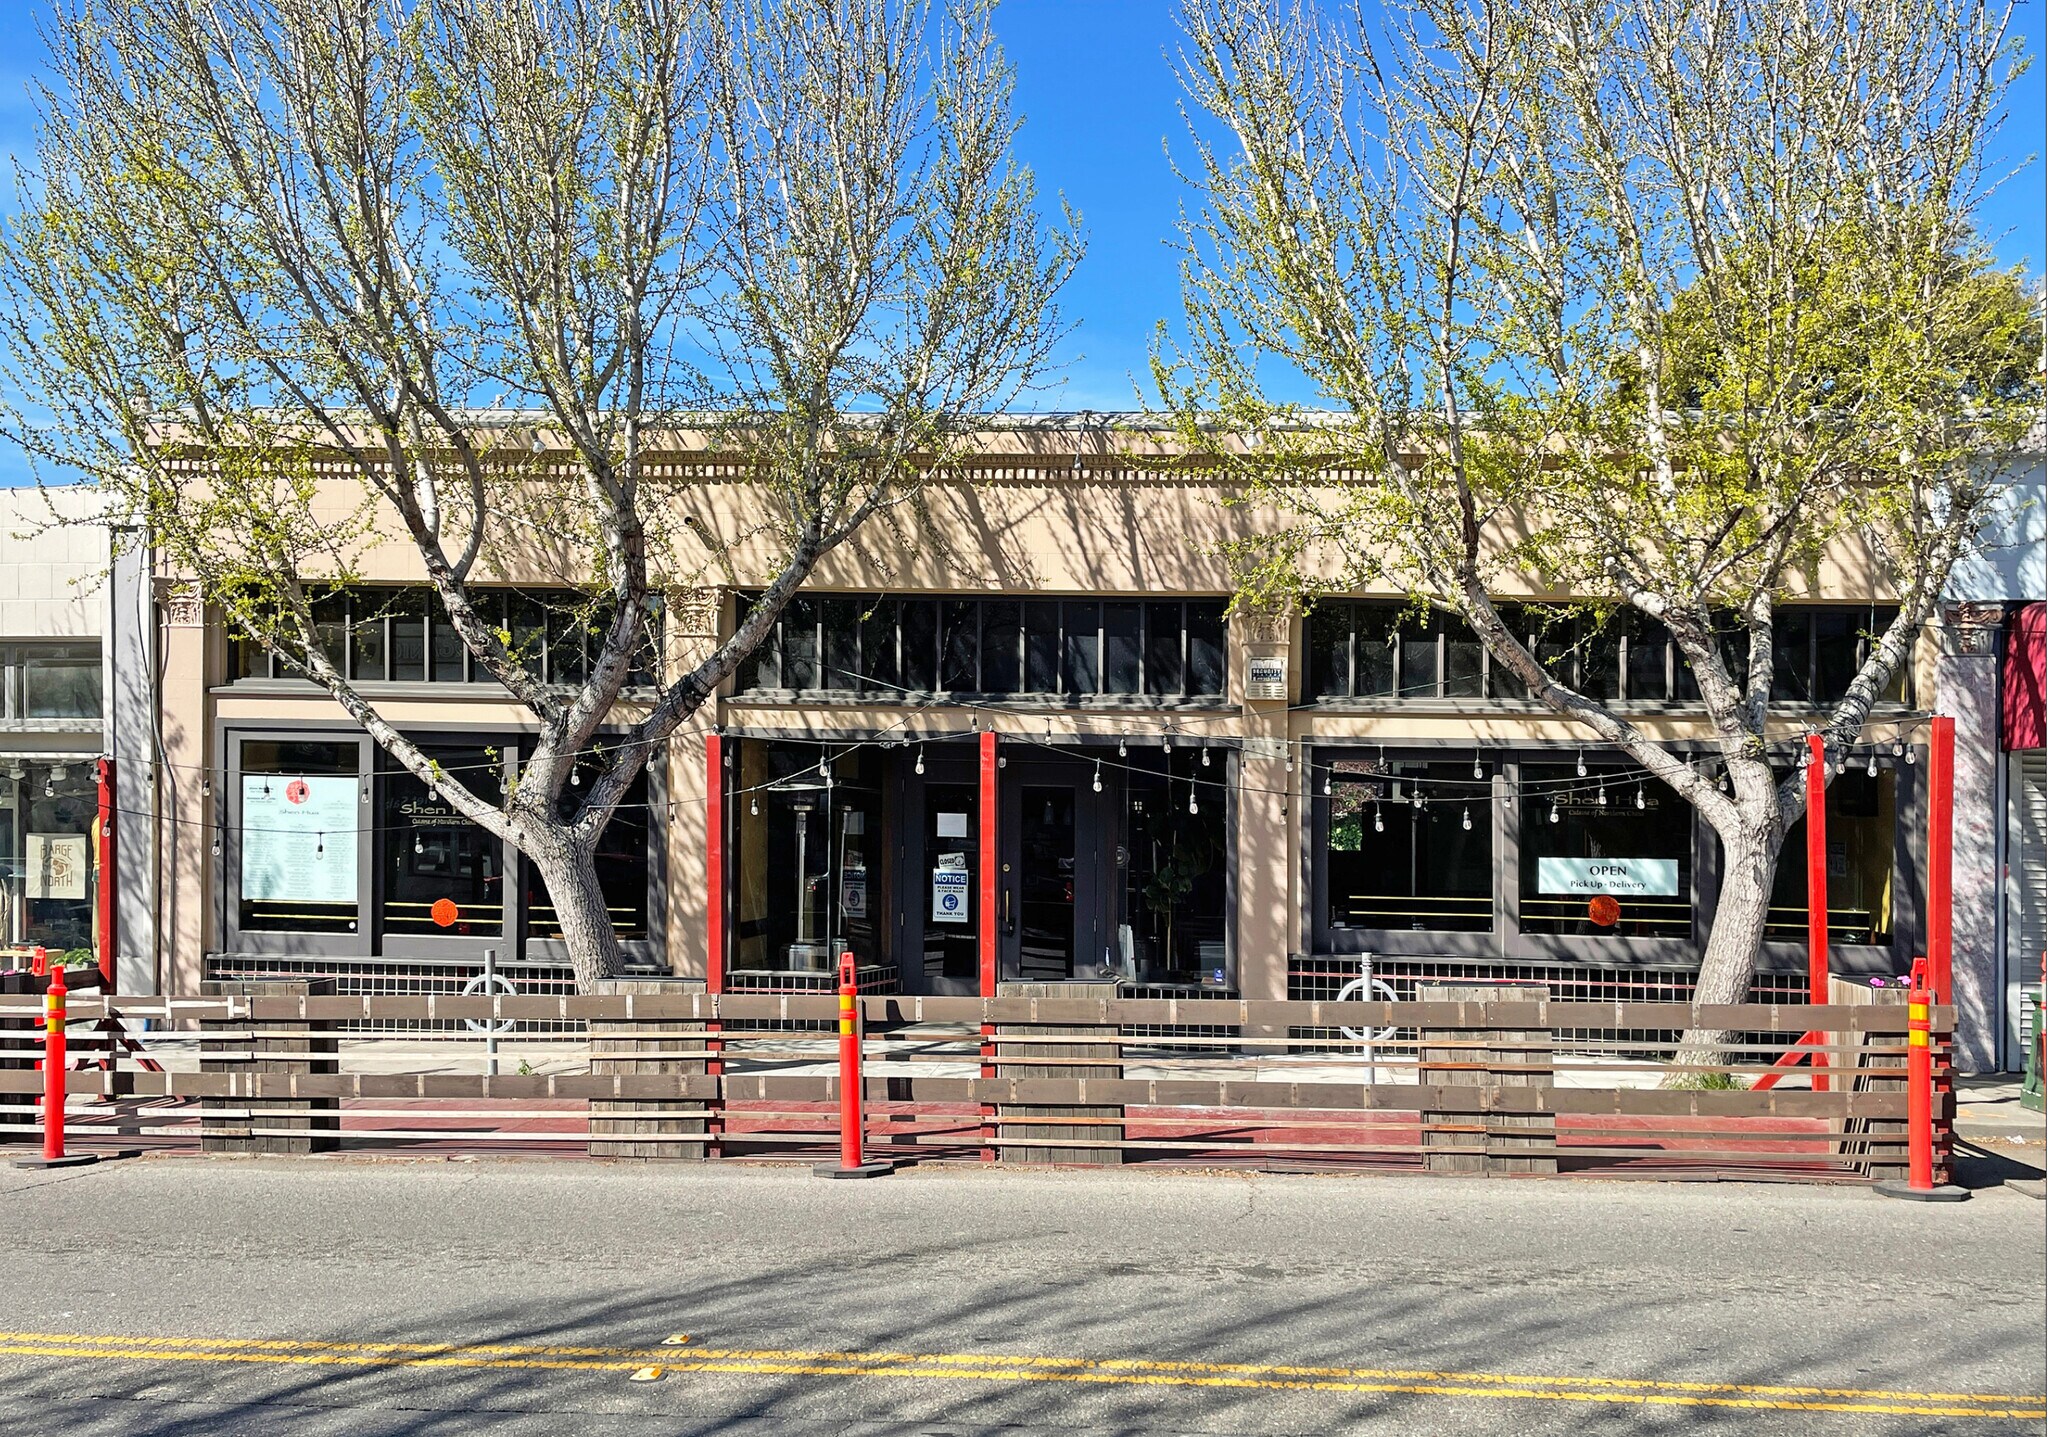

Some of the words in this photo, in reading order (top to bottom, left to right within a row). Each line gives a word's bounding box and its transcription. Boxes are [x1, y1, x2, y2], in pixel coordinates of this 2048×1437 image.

[1615, 795, 1659, 806] Ha
[399, 801, 446, 814] Shen
[41, 844, 73, 861] BARGE
[1589, 865, 1627, 876] OPEN
[40, 870, 73, 887] NORTH
[935, 874, 966, 883] NOTICE
[1570, 880, 1589, 888] Pick
[1591, 881, 1603, 889] Up
[1609, 880, 1647, 890] Delivery
